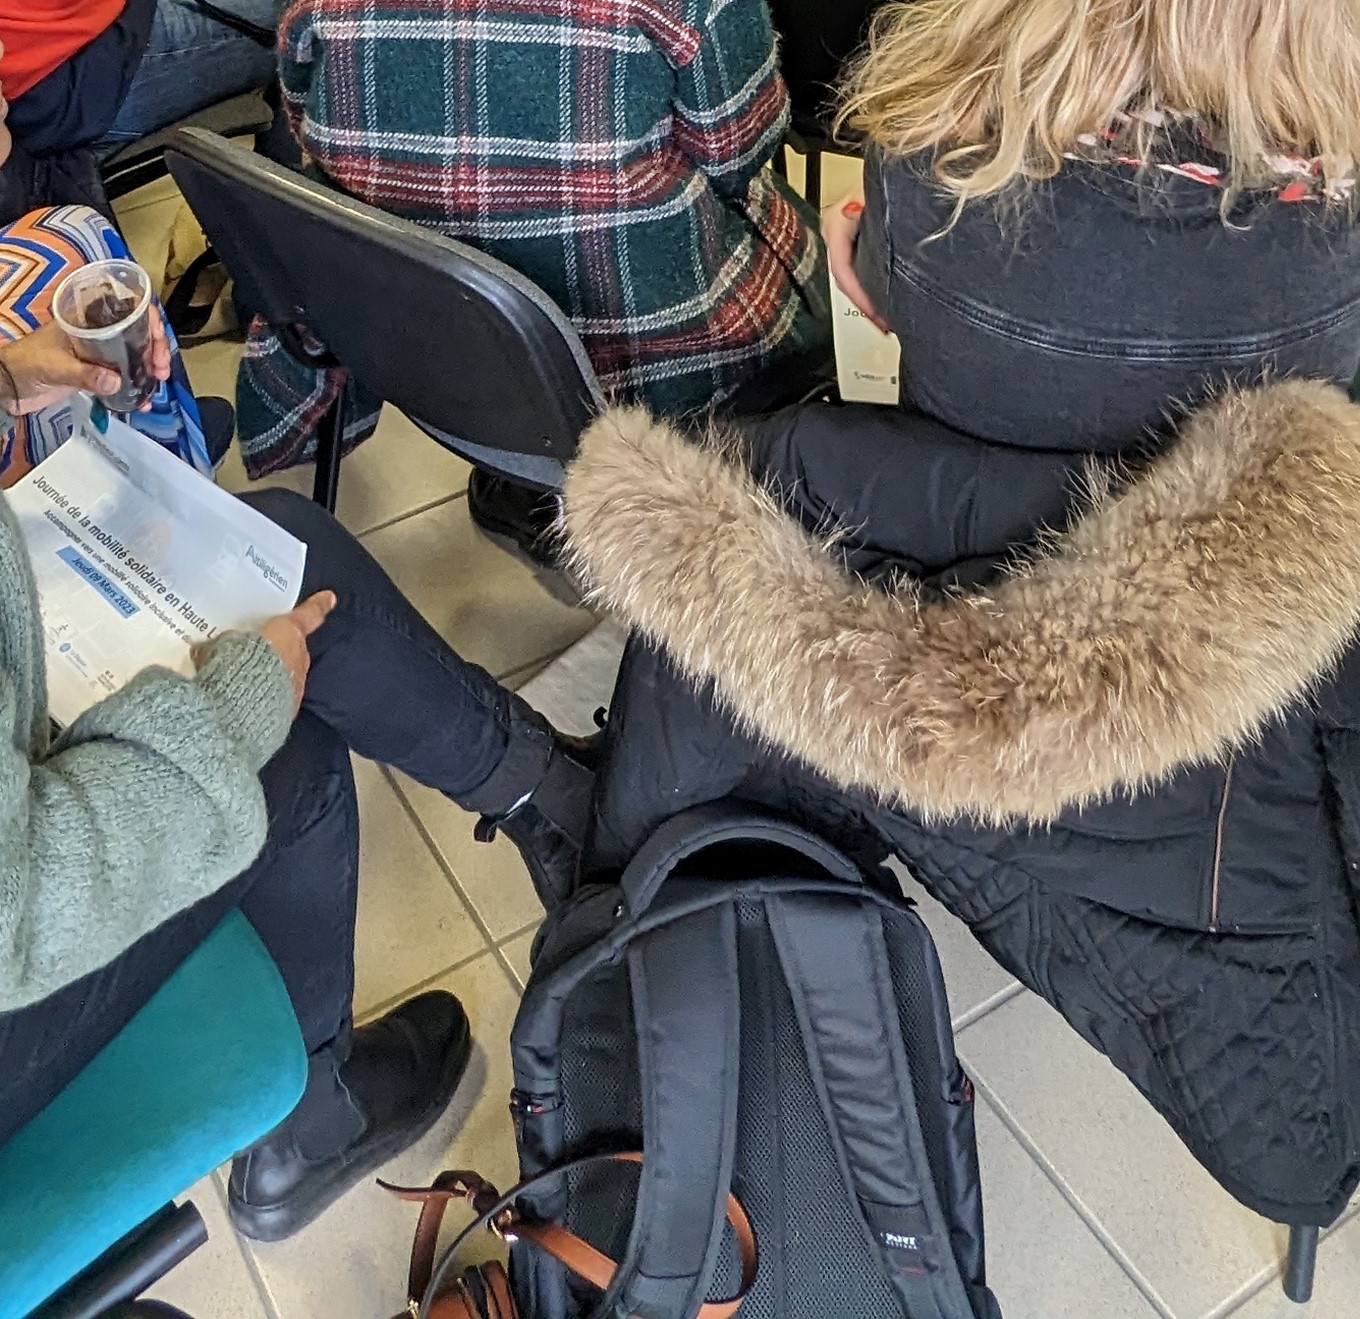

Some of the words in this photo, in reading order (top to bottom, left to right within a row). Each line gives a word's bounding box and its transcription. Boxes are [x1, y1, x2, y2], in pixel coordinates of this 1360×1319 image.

[32, 475, 70, 509] Journée
[67, 504, 82, 520] de
[78, 514, 91, 529] la
[87, 523, 129, 561] mobilité
[124, 556, 168, 596] solidaire
[164, 590, 181, 608] en
[177, 601, 211, 633] Haute
[71, 557, 94, 577] Jeudi
[89, 570, 102, 584] 09
[96, 579, 119, 600] Mars
[114, 595, 137, 615] 2023
[149, 602, 176, 630] inclusive
